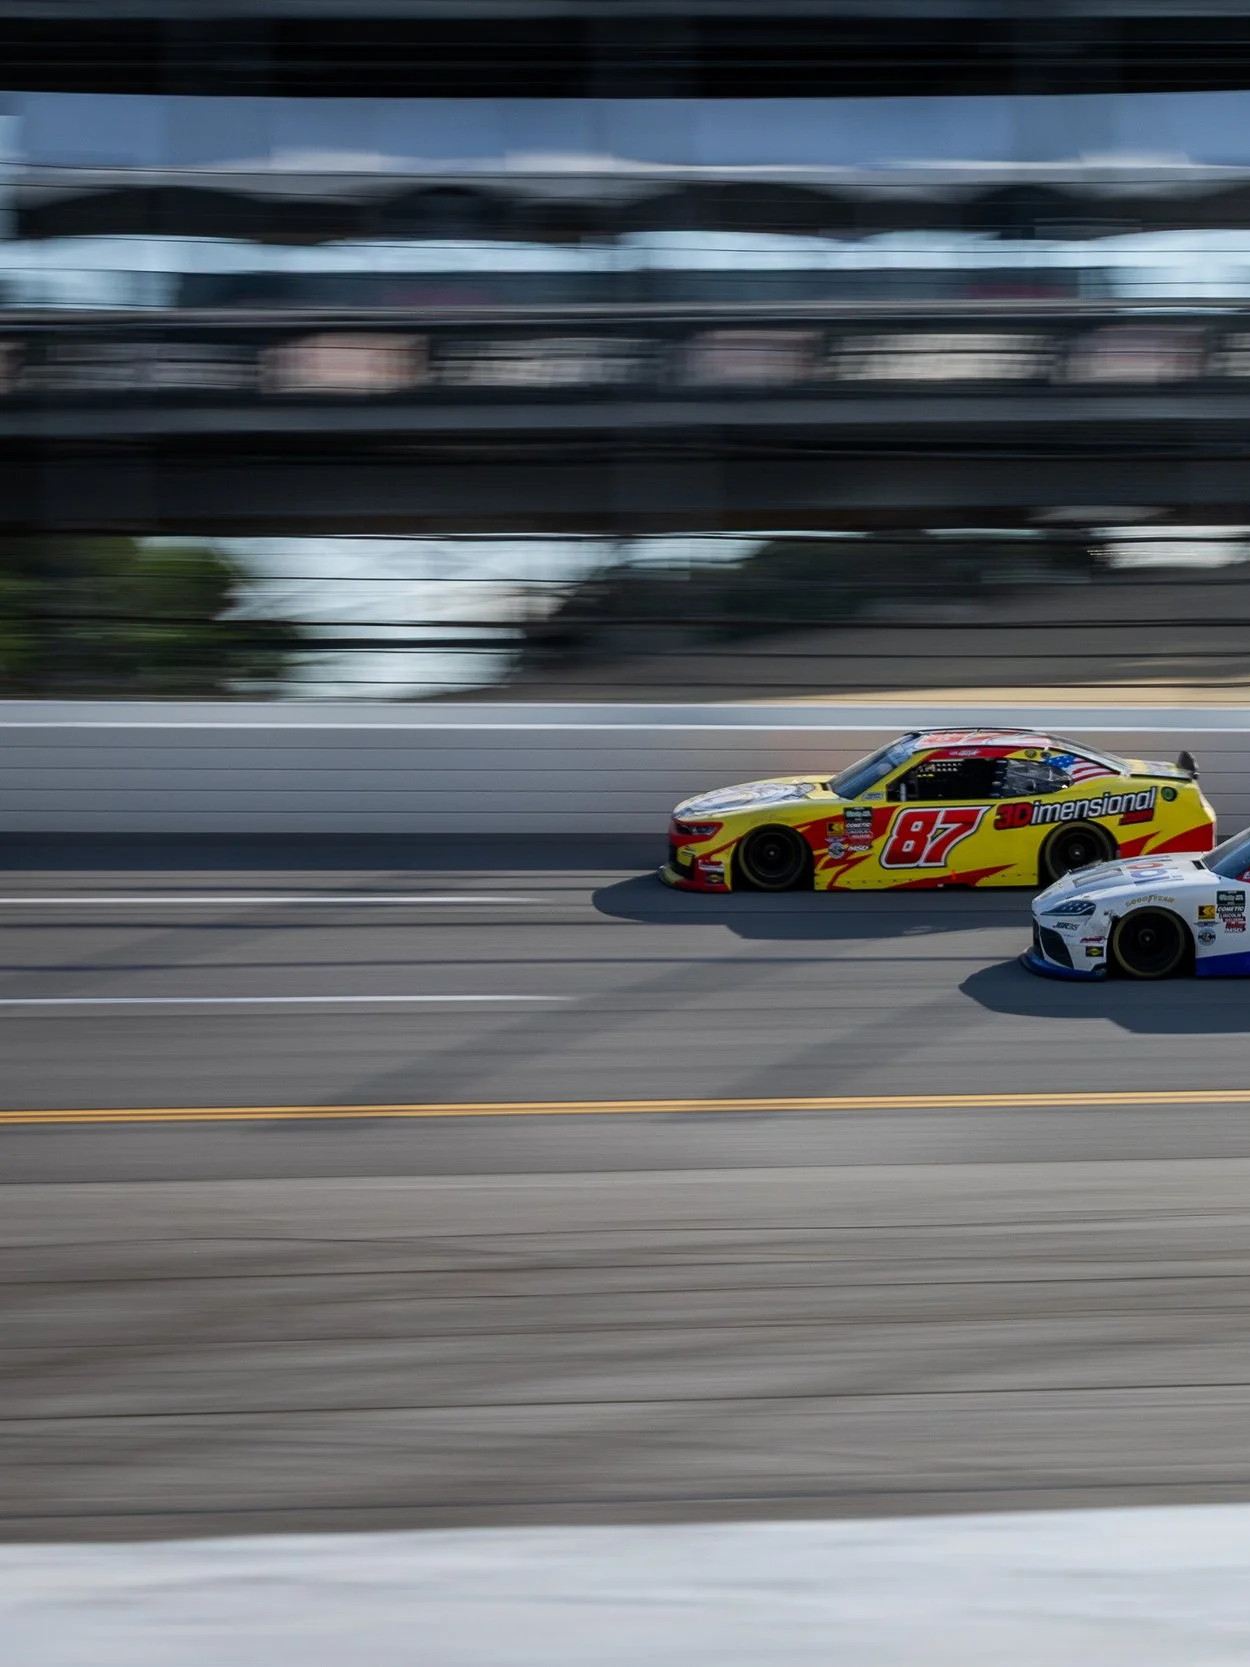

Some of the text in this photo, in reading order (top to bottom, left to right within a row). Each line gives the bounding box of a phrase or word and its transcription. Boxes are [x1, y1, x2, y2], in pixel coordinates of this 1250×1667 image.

[994, 787, 1156, 829] 3Dimensional
[881, 807, 992, 869] 87
[1125, 895, 1175, 907] GOODYEAR
